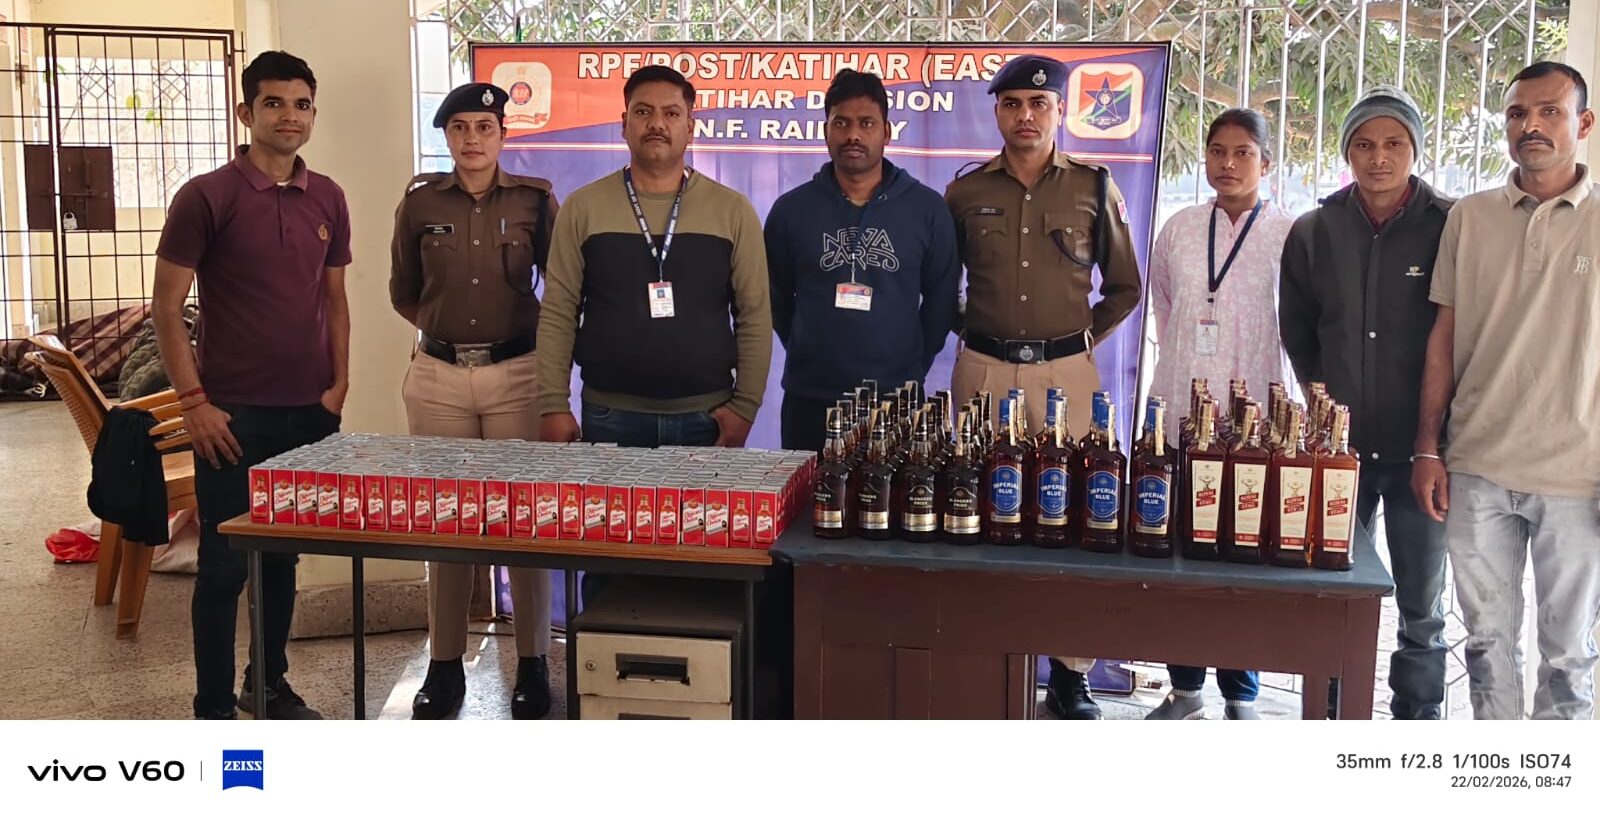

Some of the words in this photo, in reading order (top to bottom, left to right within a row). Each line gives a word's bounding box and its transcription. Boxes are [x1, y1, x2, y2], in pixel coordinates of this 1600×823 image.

[921, 53, 1023, 88] (EAS
[694, 89, 795, 110] TIHAR
[693, 118, 749, 139] N.F.
